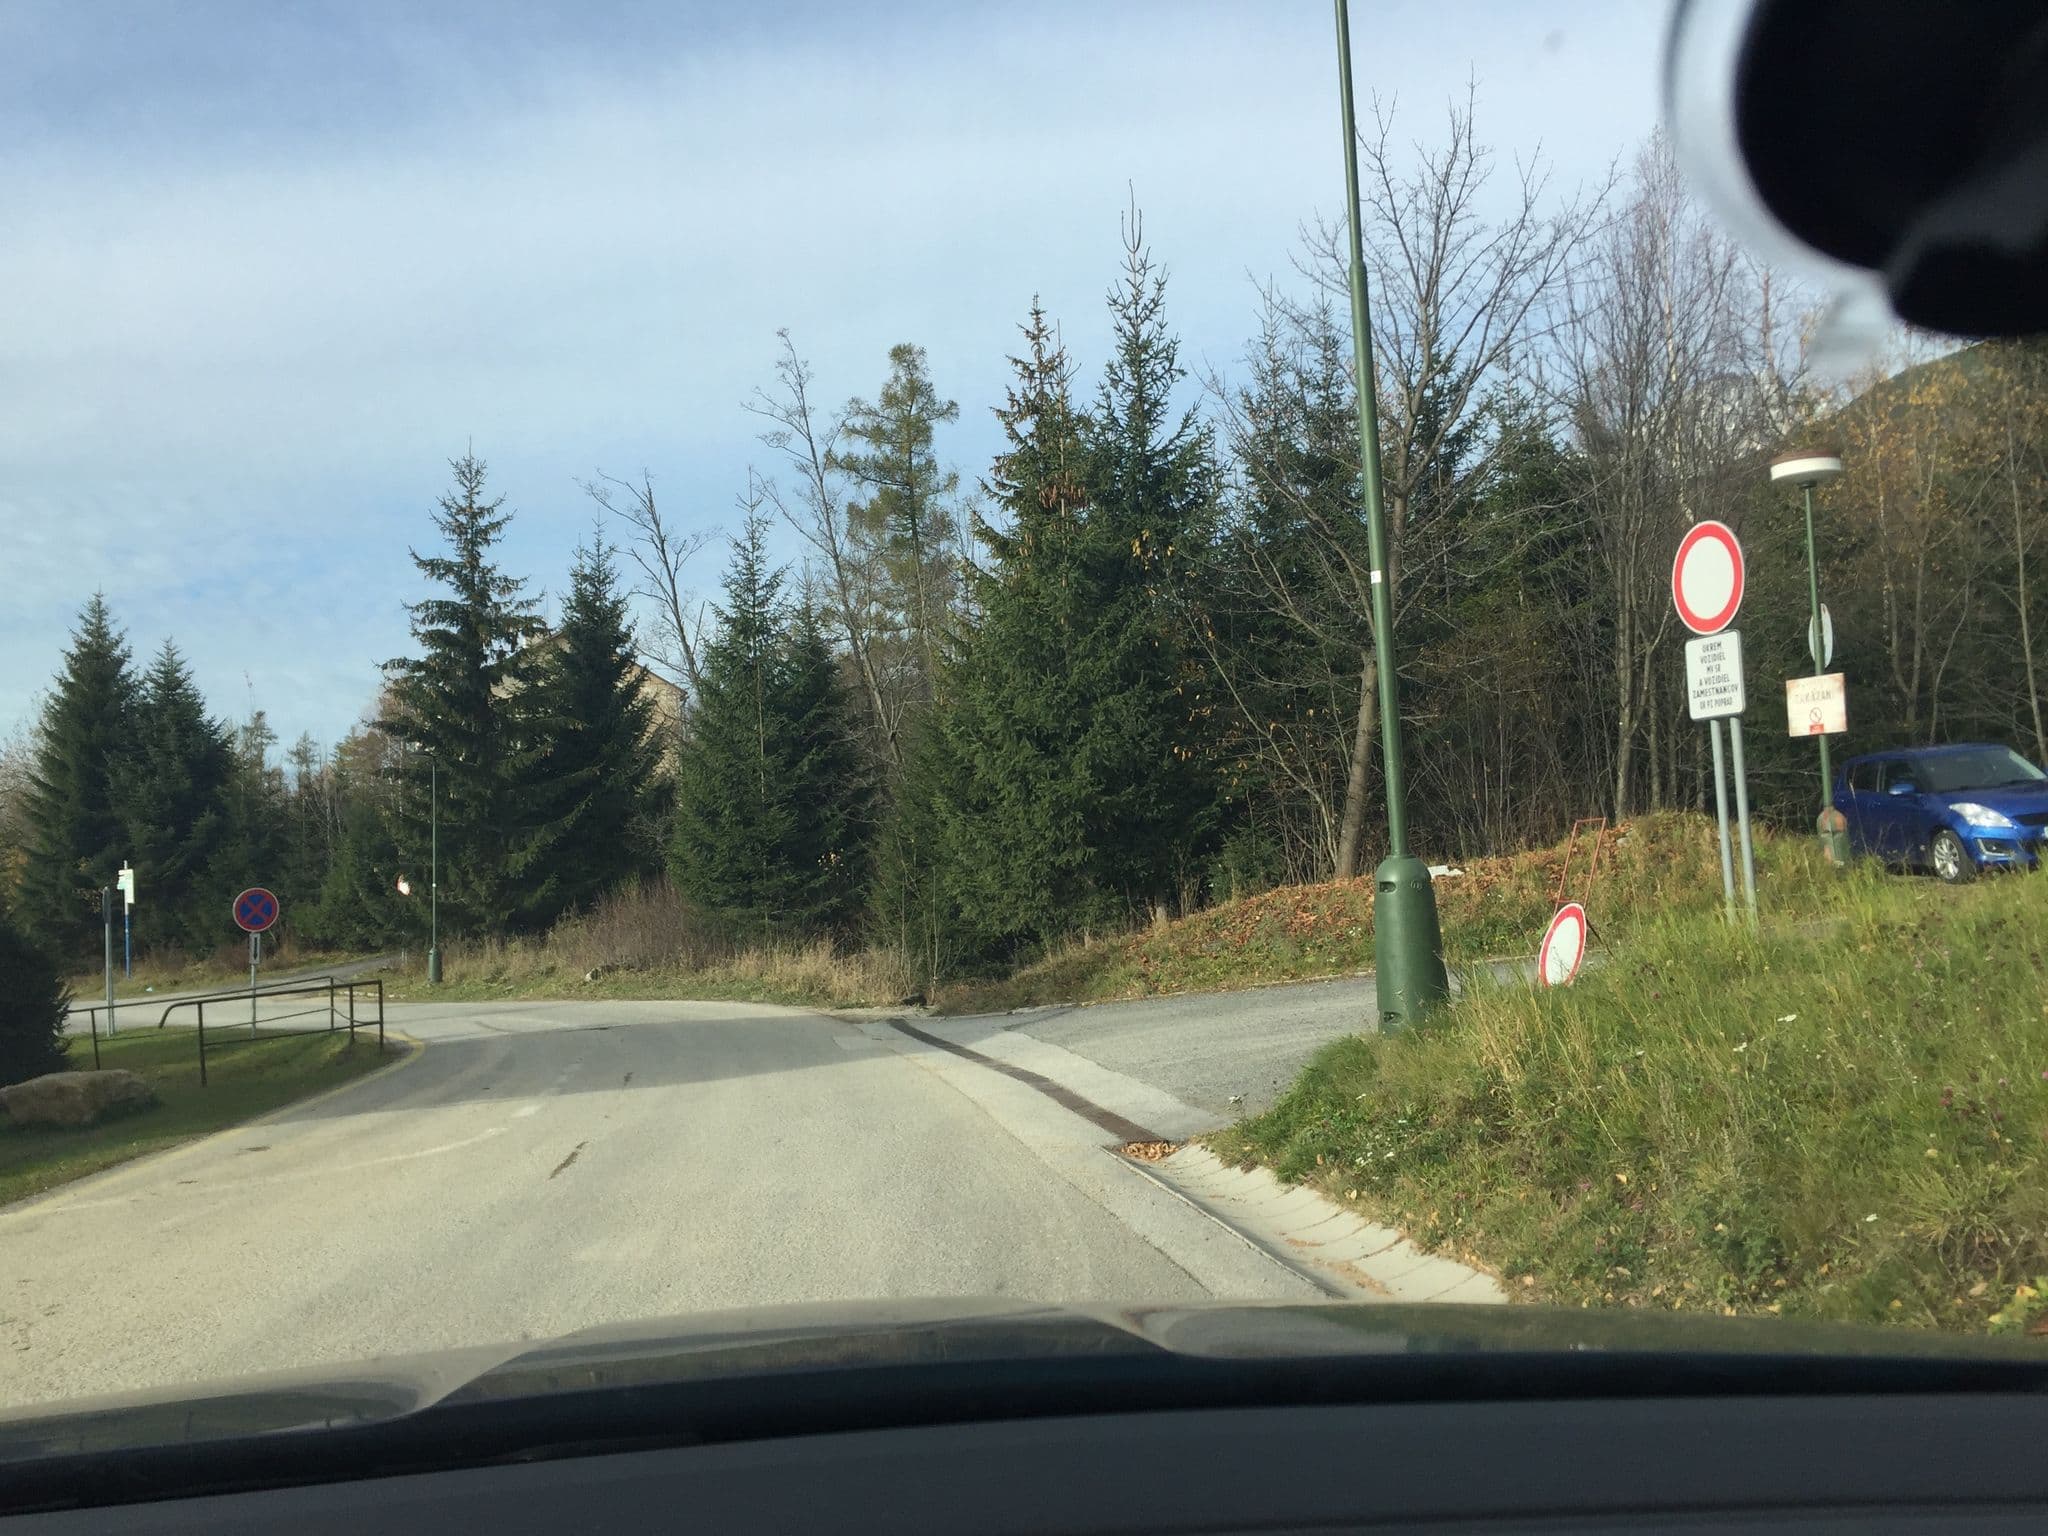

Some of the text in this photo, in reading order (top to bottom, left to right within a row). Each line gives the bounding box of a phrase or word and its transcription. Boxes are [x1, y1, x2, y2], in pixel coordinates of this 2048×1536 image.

[1702, 641, 1722, 653] OKREM
[1700, 653, 1726, 664] VOZIDIEL
[1704, 674, 1730, 685] VOZIDIEL
